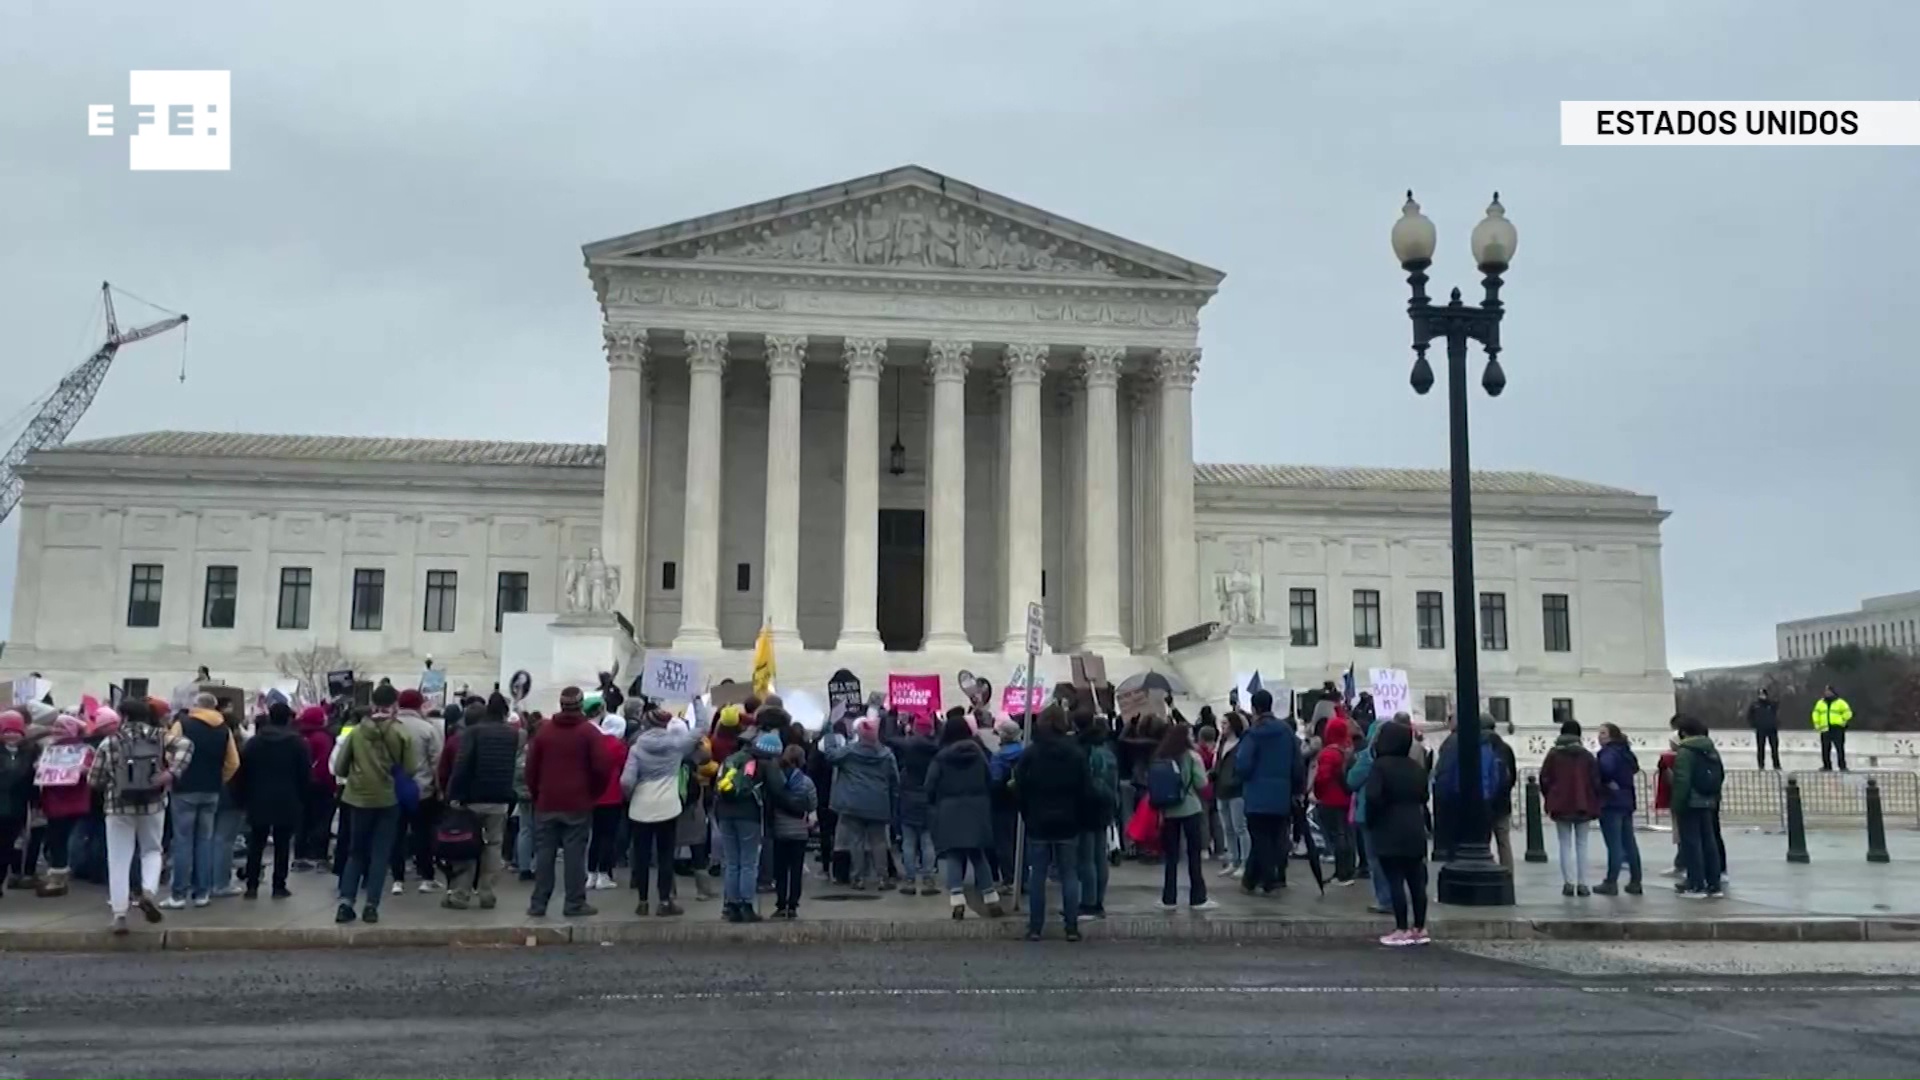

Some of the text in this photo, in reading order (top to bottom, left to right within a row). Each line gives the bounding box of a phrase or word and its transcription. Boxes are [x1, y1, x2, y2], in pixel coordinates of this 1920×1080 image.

[656, 670, 688, 681] WITH
[1379, 669, 1396, 680] MY
[657, 679, 687, 692] THEM
[909, 689, 932, 698] OUR
[1373, 683, 1407, 700] BODY
[1383, 699, 1399, 710] MY
